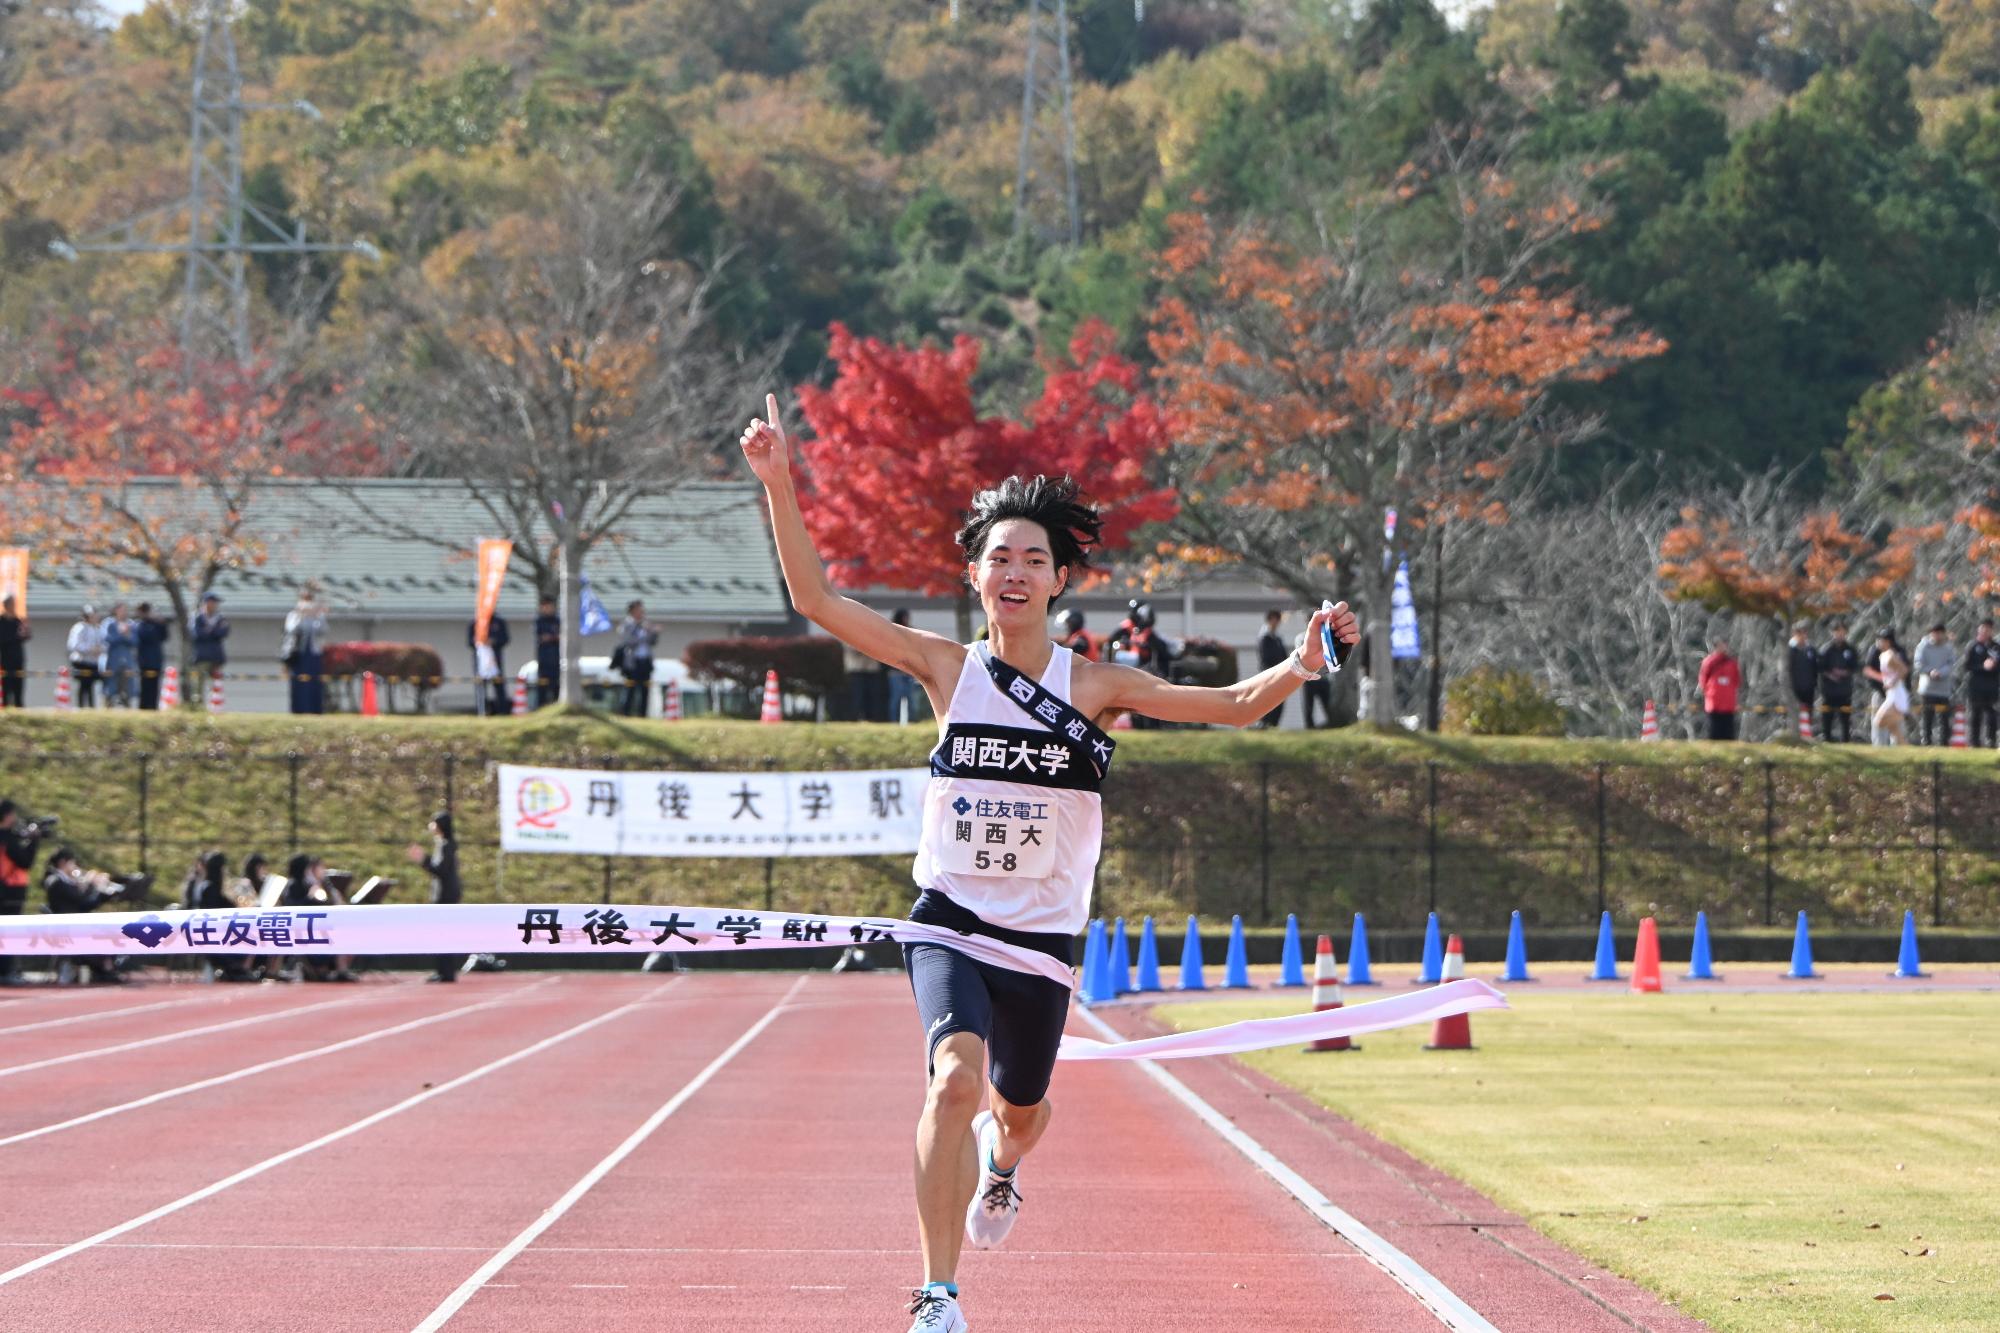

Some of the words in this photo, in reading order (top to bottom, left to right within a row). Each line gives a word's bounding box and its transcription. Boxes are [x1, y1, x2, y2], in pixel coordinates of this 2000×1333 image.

[951, 735, 1071, 776] 関西大学
[974, 798, 1049, 821] 住友電工
[955, 820, 1043, 847] 関西大
[974, 850, 1018, 872] 5-8
[180, 911, 330, 948] 住友電工
